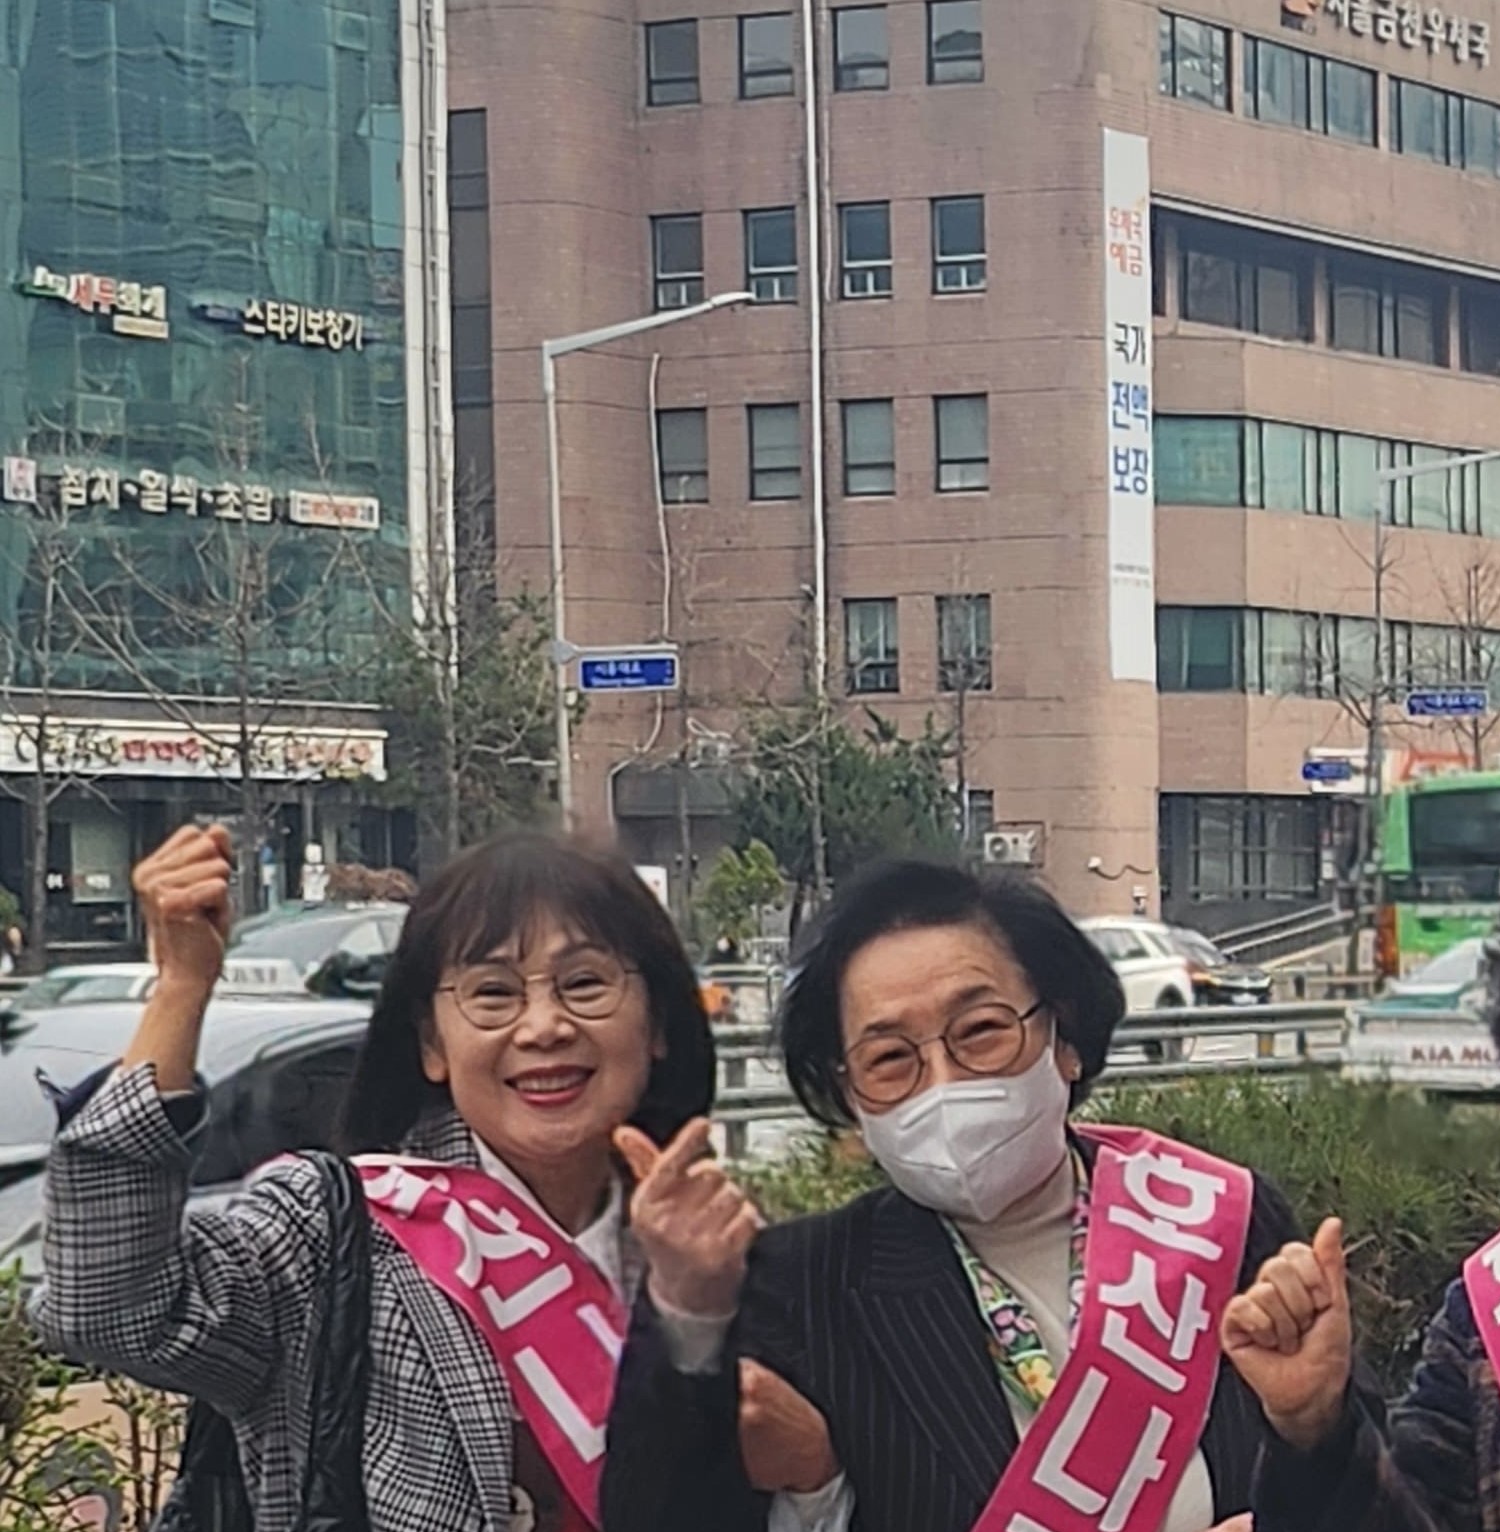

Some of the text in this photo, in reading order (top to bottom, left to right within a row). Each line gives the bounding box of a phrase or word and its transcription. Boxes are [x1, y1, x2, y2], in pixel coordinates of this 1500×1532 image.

[1109, 242, 1142, 277] 예금
[243, 299, 363, 351] 스타키보청기
[1114, 322, 1146, 366] 국가
[1112, 382, 1149, 432] 전액
[1113, 446, 1149, 494] 보장
[1410, 1043, 1455, 1063] KIA
